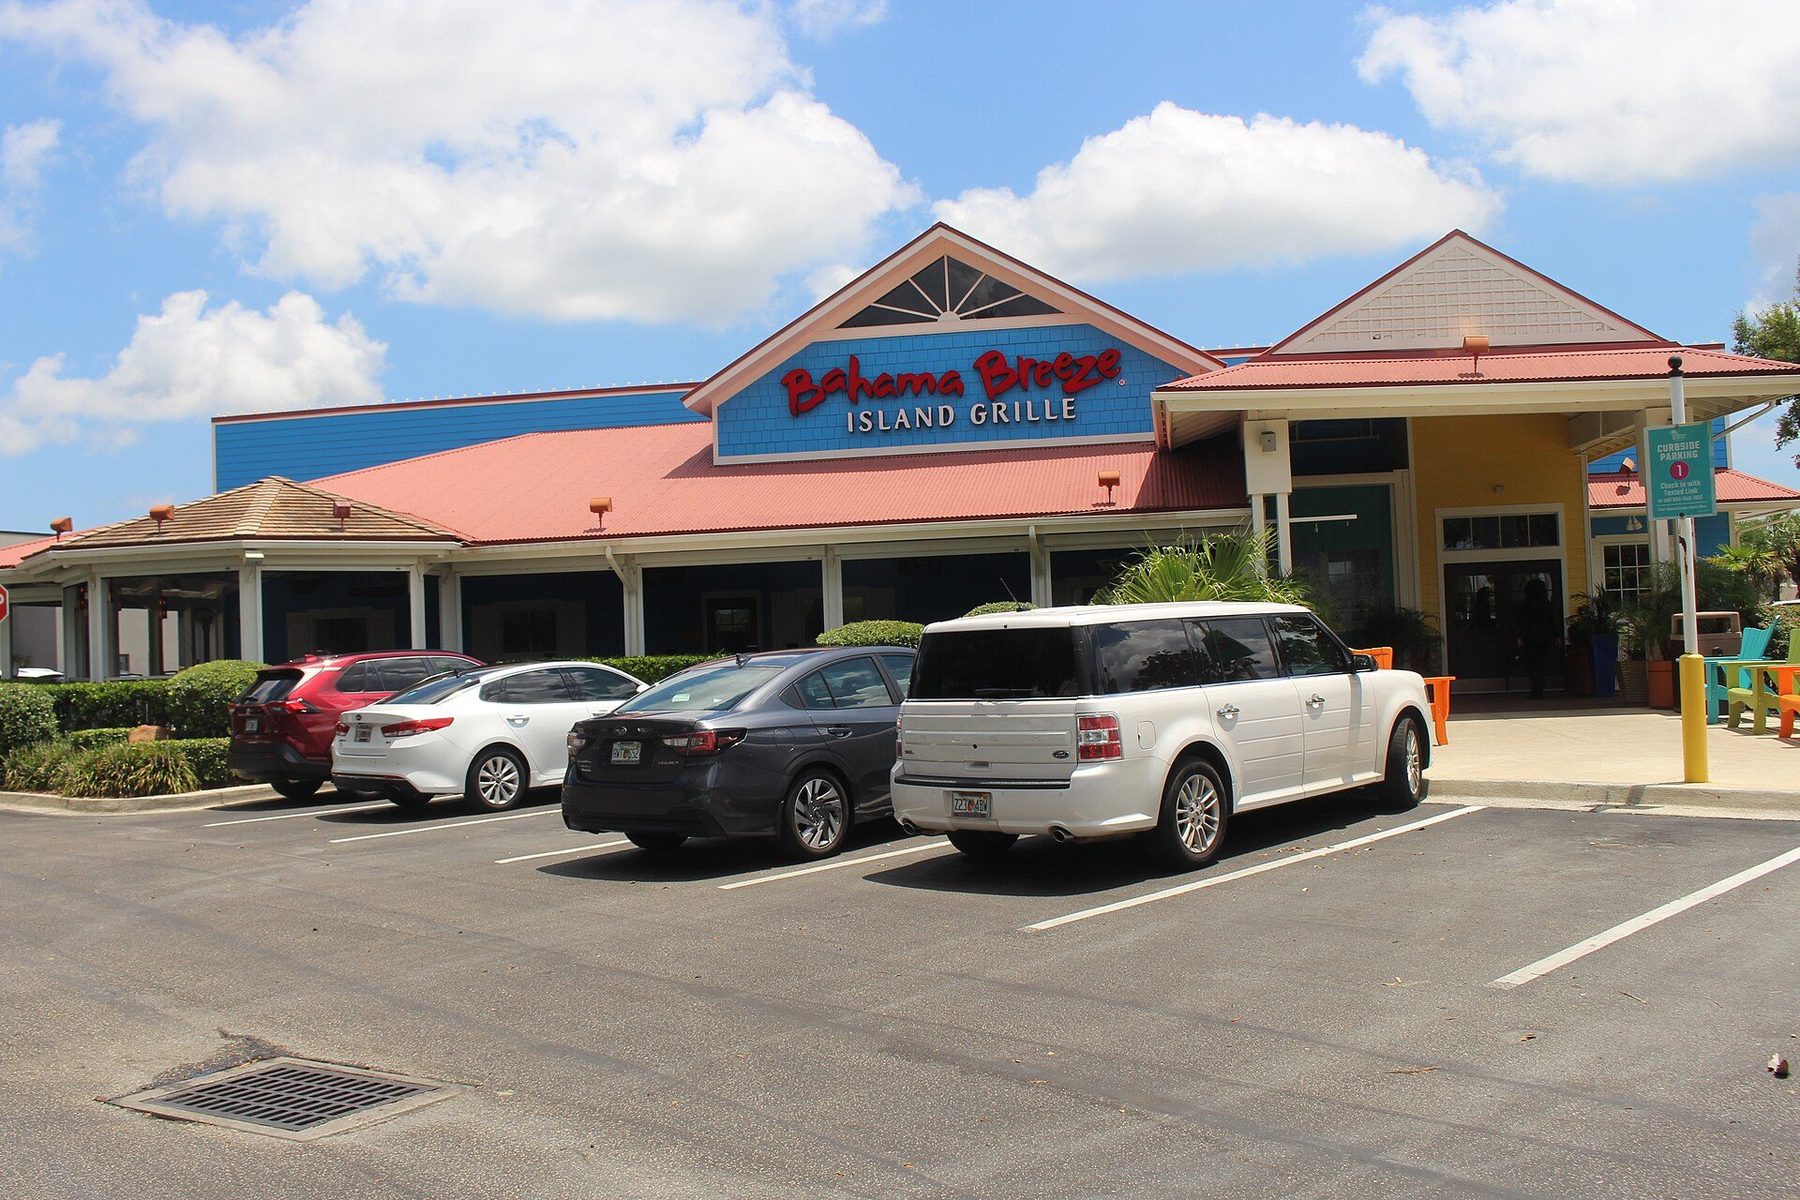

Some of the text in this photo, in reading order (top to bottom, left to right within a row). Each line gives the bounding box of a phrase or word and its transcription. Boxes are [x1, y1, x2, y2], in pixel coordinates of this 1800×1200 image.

[781, 348, 1121, 417] Bahama Breeze
[847, 398, 1076, 432] ISLAND GRILLE
[1657, 441, 1700, 453] CURBSIDE
[1660, 450, 1698, 461] PARKING
[1676, 464, 1682, 477] 1
